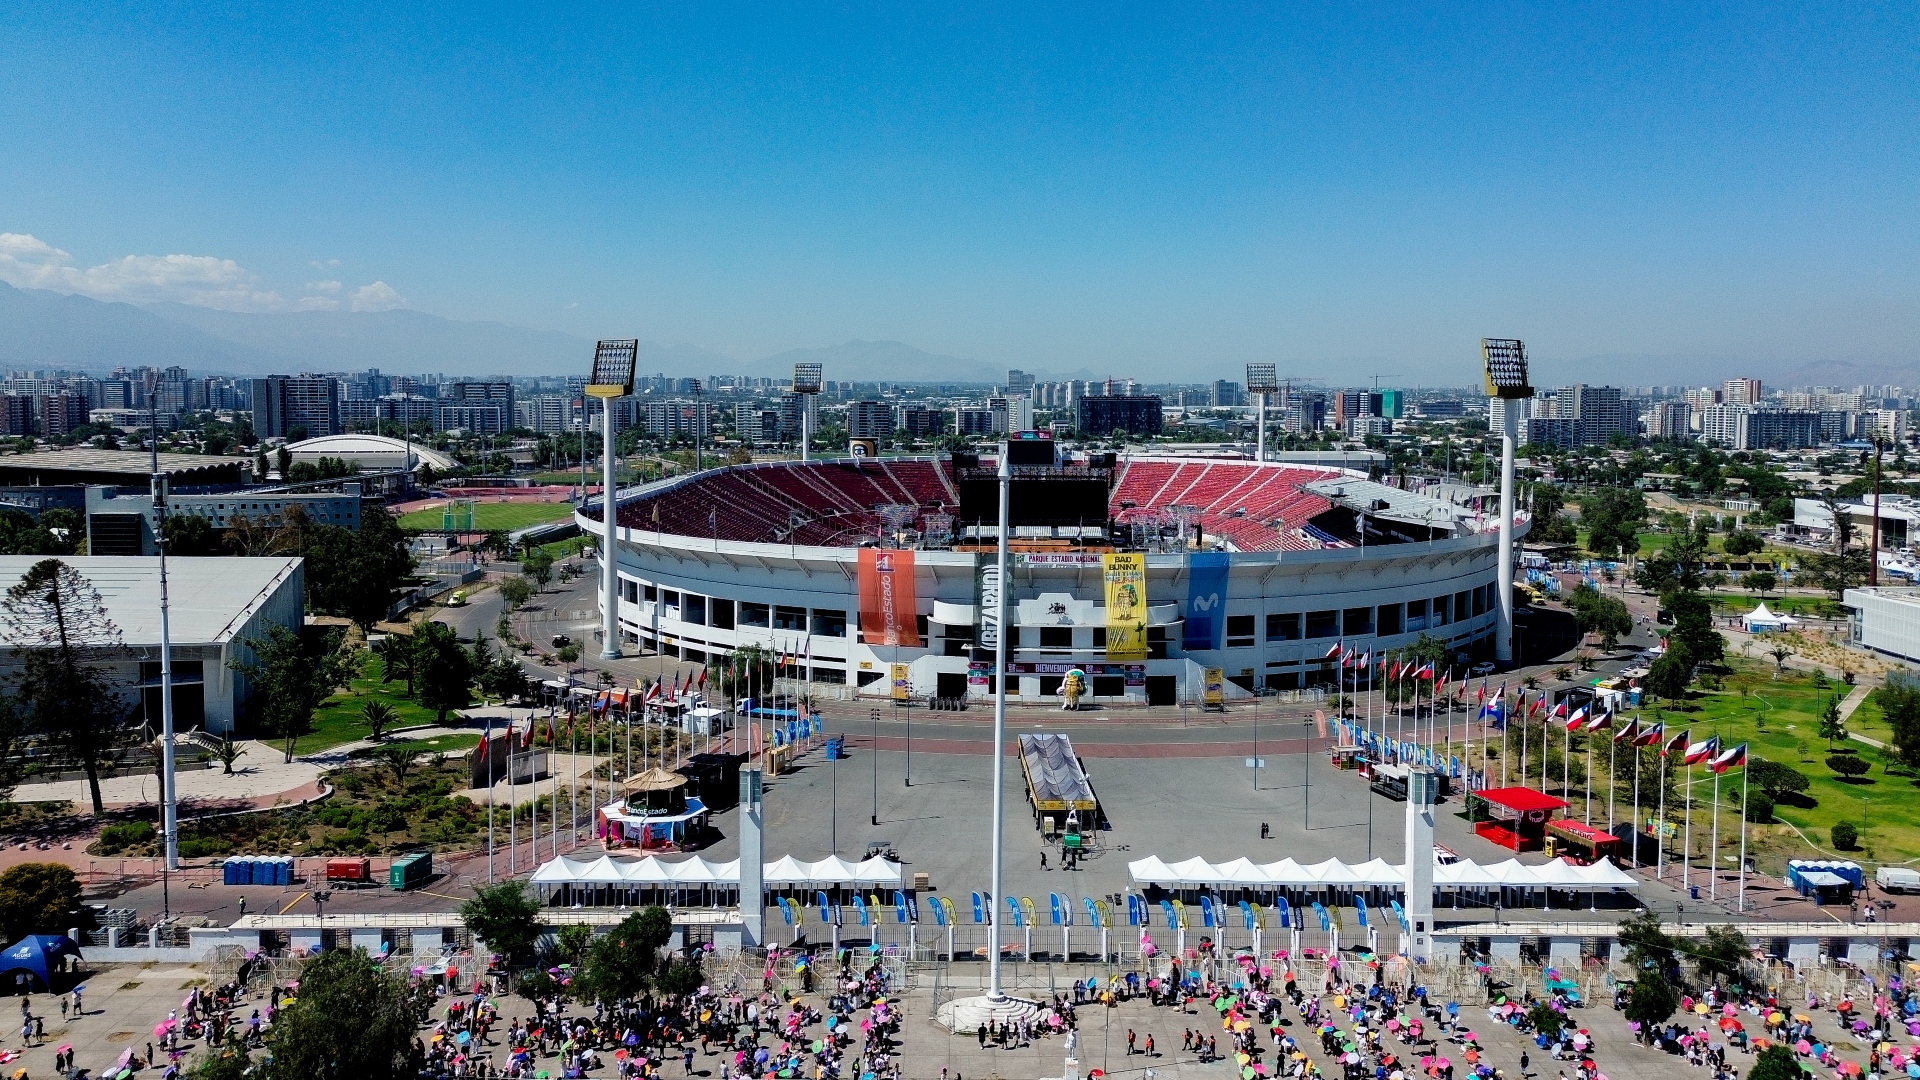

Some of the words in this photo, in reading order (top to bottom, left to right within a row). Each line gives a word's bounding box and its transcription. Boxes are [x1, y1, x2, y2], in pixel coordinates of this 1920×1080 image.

[1029, 555, 1048, 563] PARQUE
[1052, 555, 1073, 563] ESTADIO
[1076, 555, 1101, 563] NACIONAL
[883, 575, 897, 645] BancoEstado
